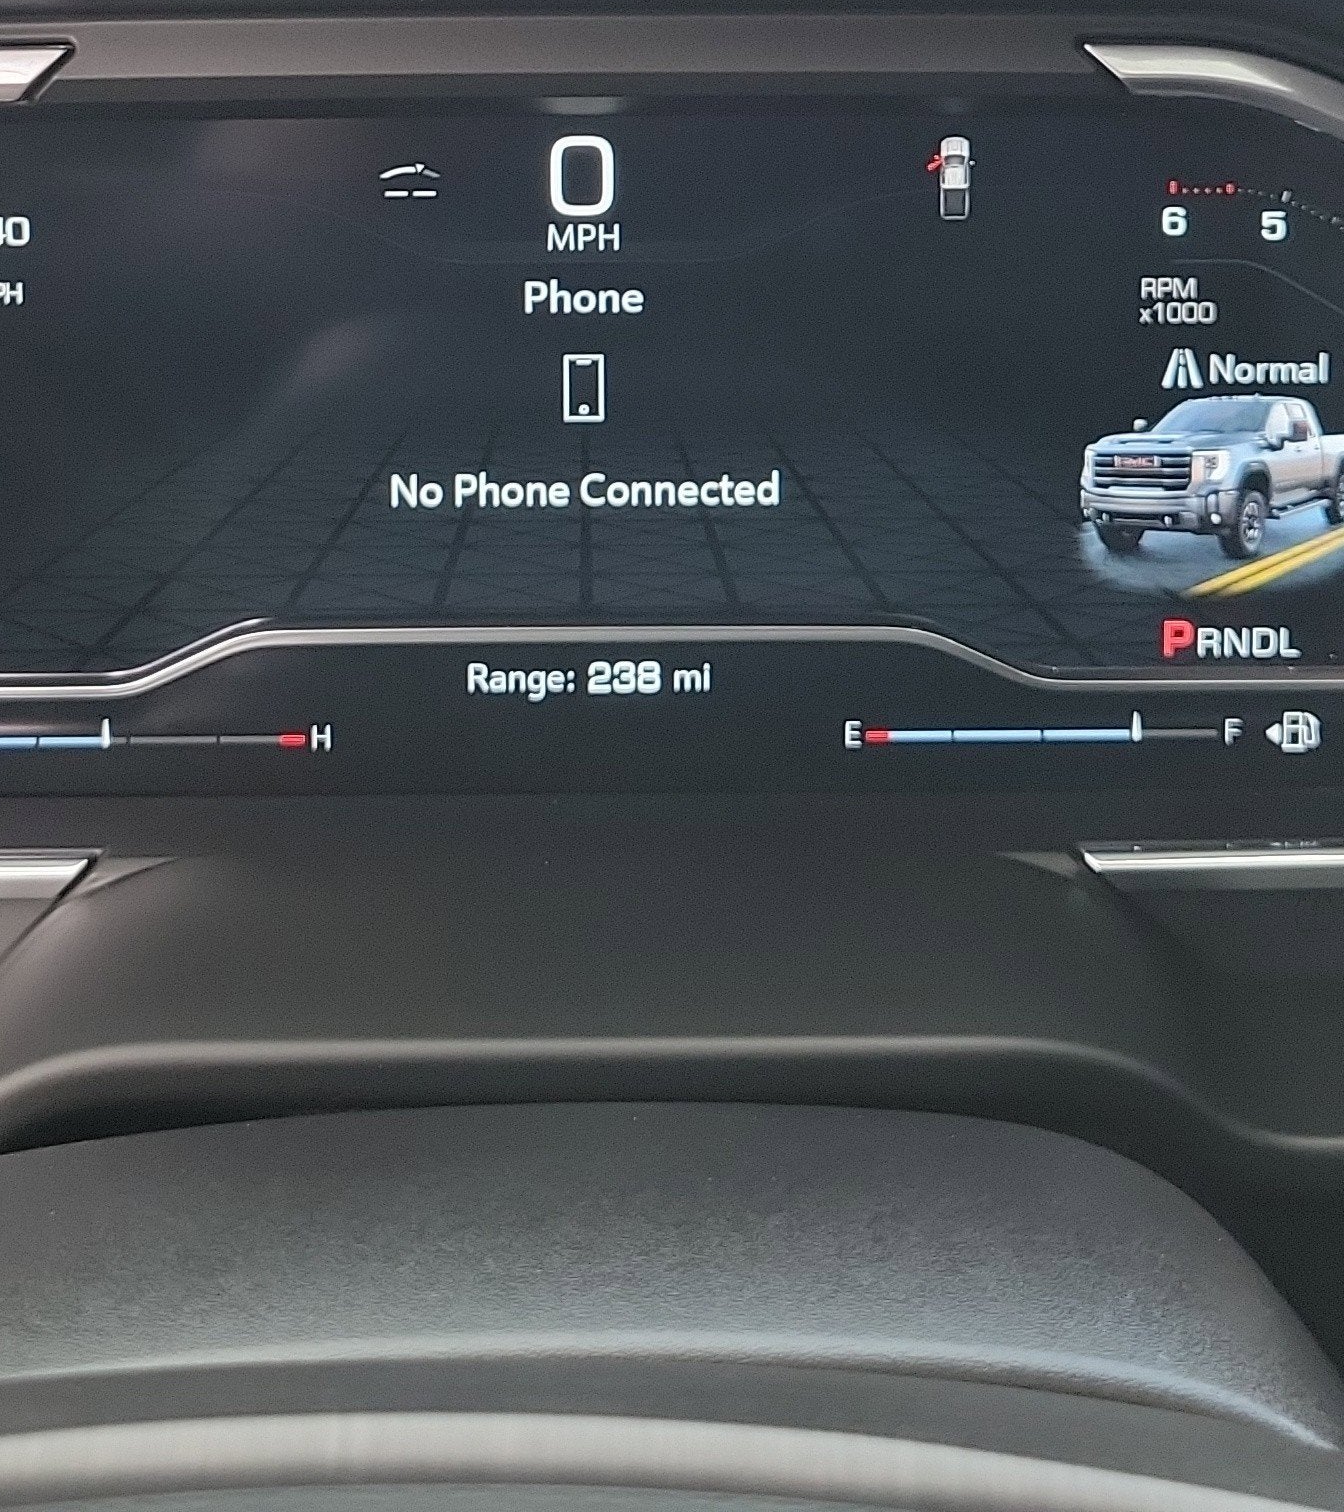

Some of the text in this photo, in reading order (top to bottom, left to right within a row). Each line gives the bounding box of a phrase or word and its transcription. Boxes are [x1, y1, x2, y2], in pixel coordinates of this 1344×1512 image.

[549, 135, 615, 217] 0
[1161, 206, 1188, 236] 6
[1261, 210, 1288, 242] 5
[546, 223, 622, 252] MPH
[523, 279, 645, 314] Phone
[1140, 277, 1198, 300] RPM
[1138, 301, 1218, 325] x1000
[1208, 351, 1330, 385] Normal
[389, 470, 781, 509] No Phone Connected
[466, 660, 711, 701] Range: 238 mi
[310, 723, 333, 753] H
[844, 720, 864, 749] E
[1224, 717, 1244, 746] F
